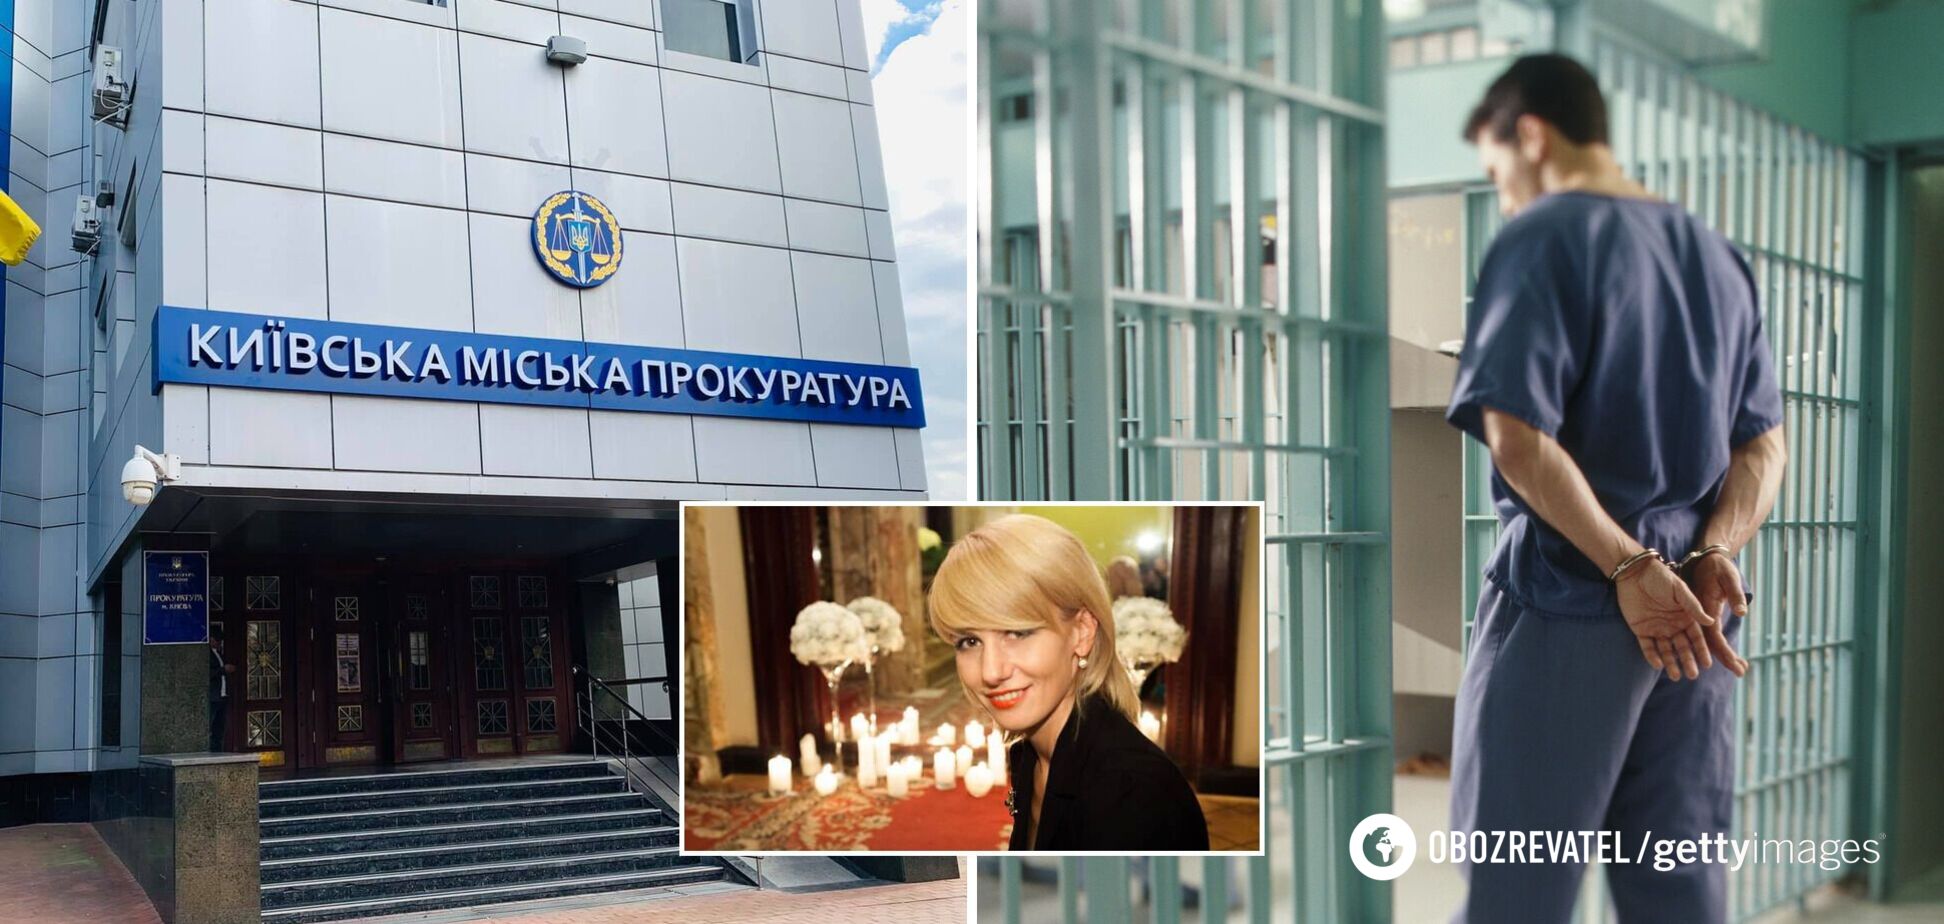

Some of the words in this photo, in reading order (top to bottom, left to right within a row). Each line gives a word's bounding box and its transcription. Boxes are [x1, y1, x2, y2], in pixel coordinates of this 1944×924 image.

[190, 319, 451, 381] КИЇВСЬКА
[462, 345, 632, 392] МІСЬКА
[640, 358, 913, 410] ПРОКУРАТУРА
